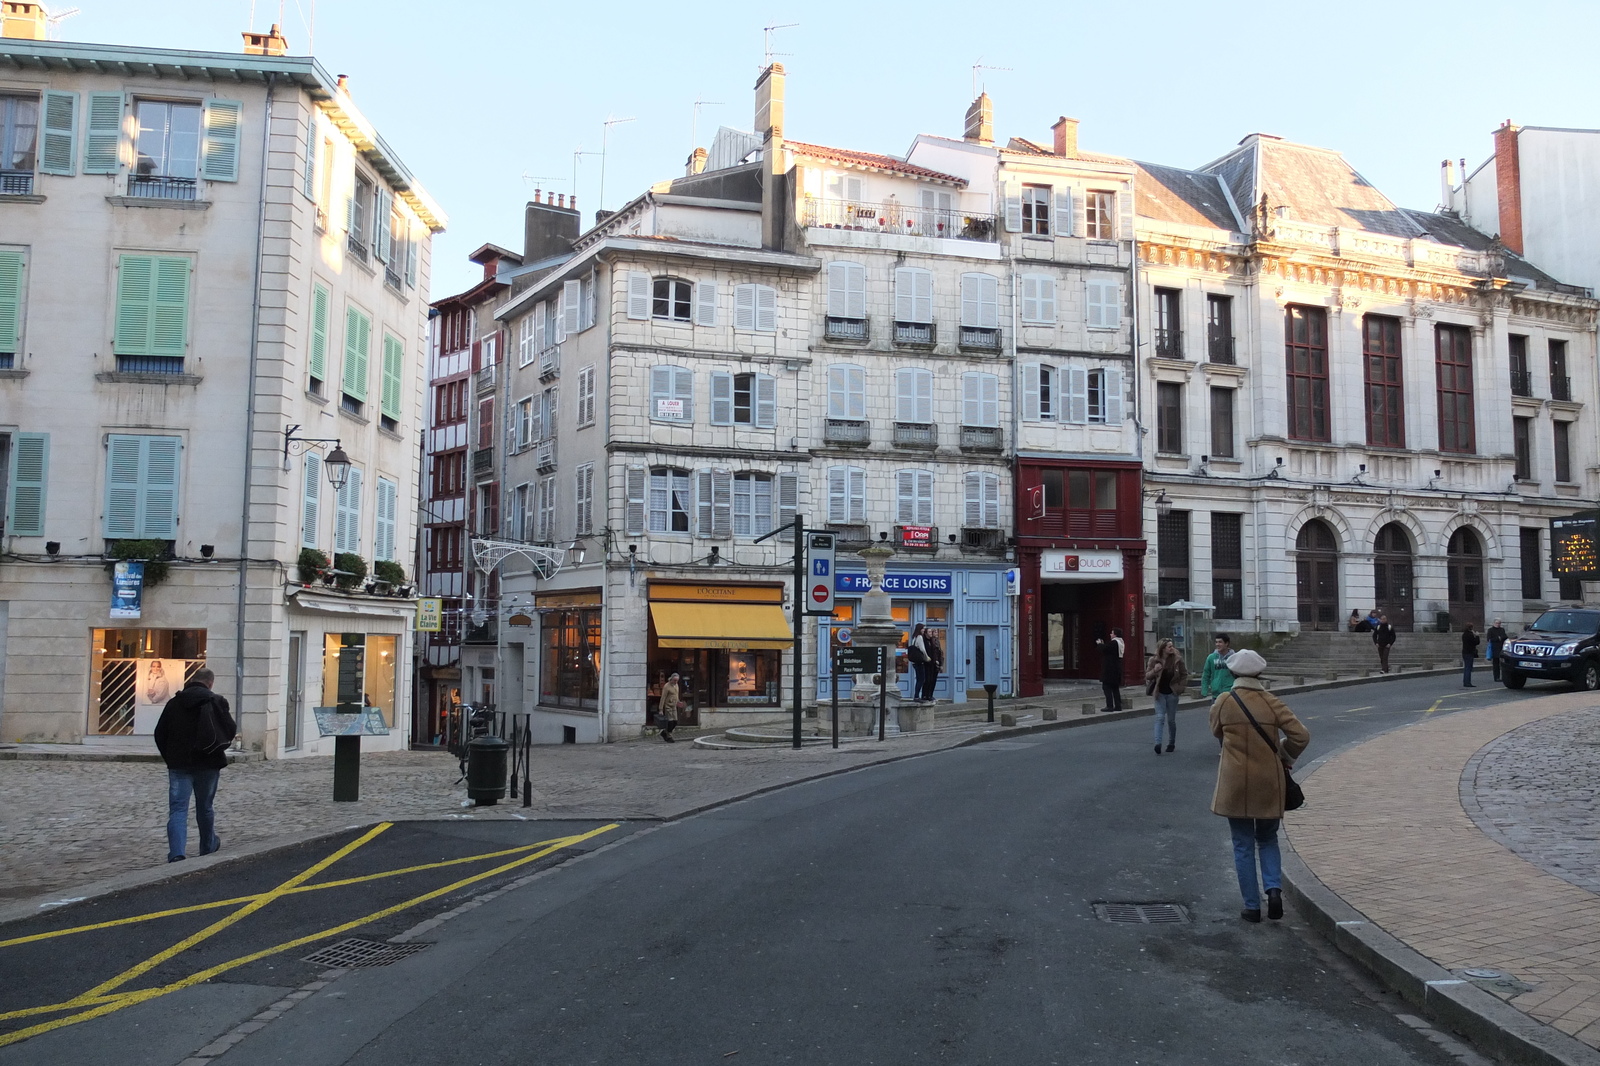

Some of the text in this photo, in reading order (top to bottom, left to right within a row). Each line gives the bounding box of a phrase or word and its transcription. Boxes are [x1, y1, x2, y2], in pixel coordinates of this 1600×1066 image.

[1053, 562, 1064, 570] LE
[903, 578, 947, 589] LOISIRS
[697, 587, 736, 595] L'OCCITANE
[420, 620, 438, 629] Claire
